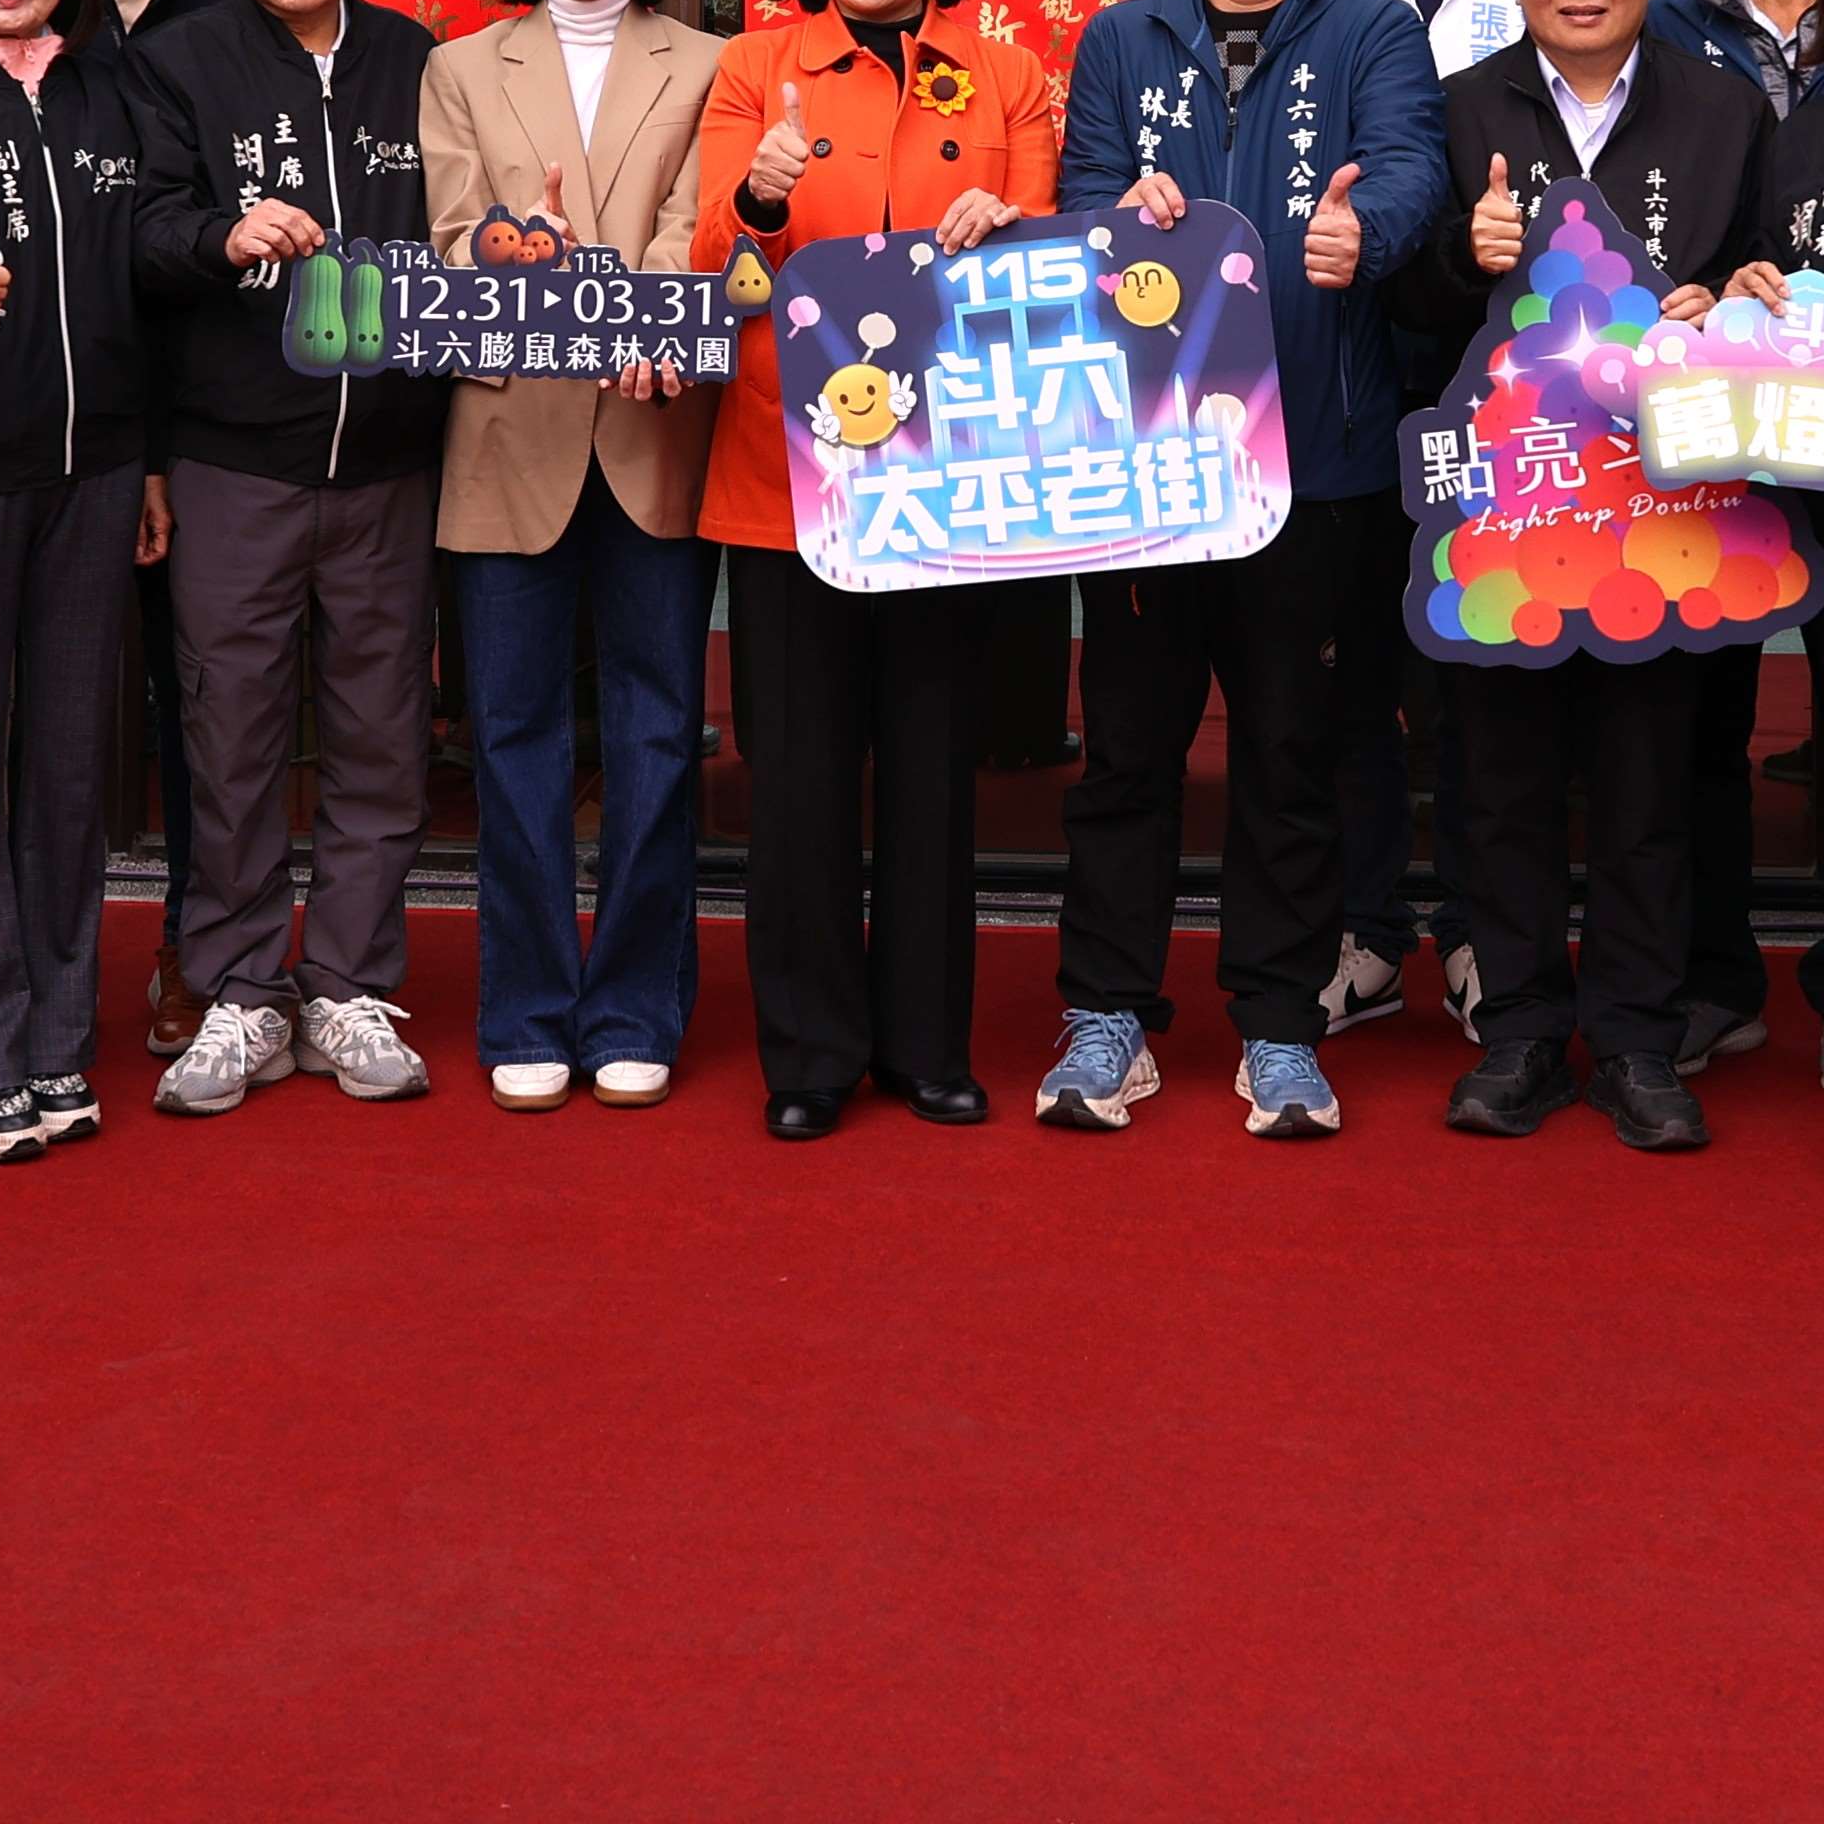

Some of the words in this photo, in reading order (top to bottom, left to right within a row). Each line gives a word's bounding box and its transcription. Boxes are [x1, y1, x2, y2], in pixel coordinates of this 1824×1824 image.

[1169, 66, 1200, 129] 市長
[273, 113, 305, 190] 主席
[1286, 63, 1318, 219] 斗六市公所
[391, 275, 529, 322] 12.31
[944, 245, 1088, 306] 115
[936, 334, 1125, 431] 斗六
[852, 435, 1226, 558] 太平老街
[1471, 501, 1571, 542] Light
[1571, 506, 1617, 533] up
[1632, 486, 1743, 520] Douliu
